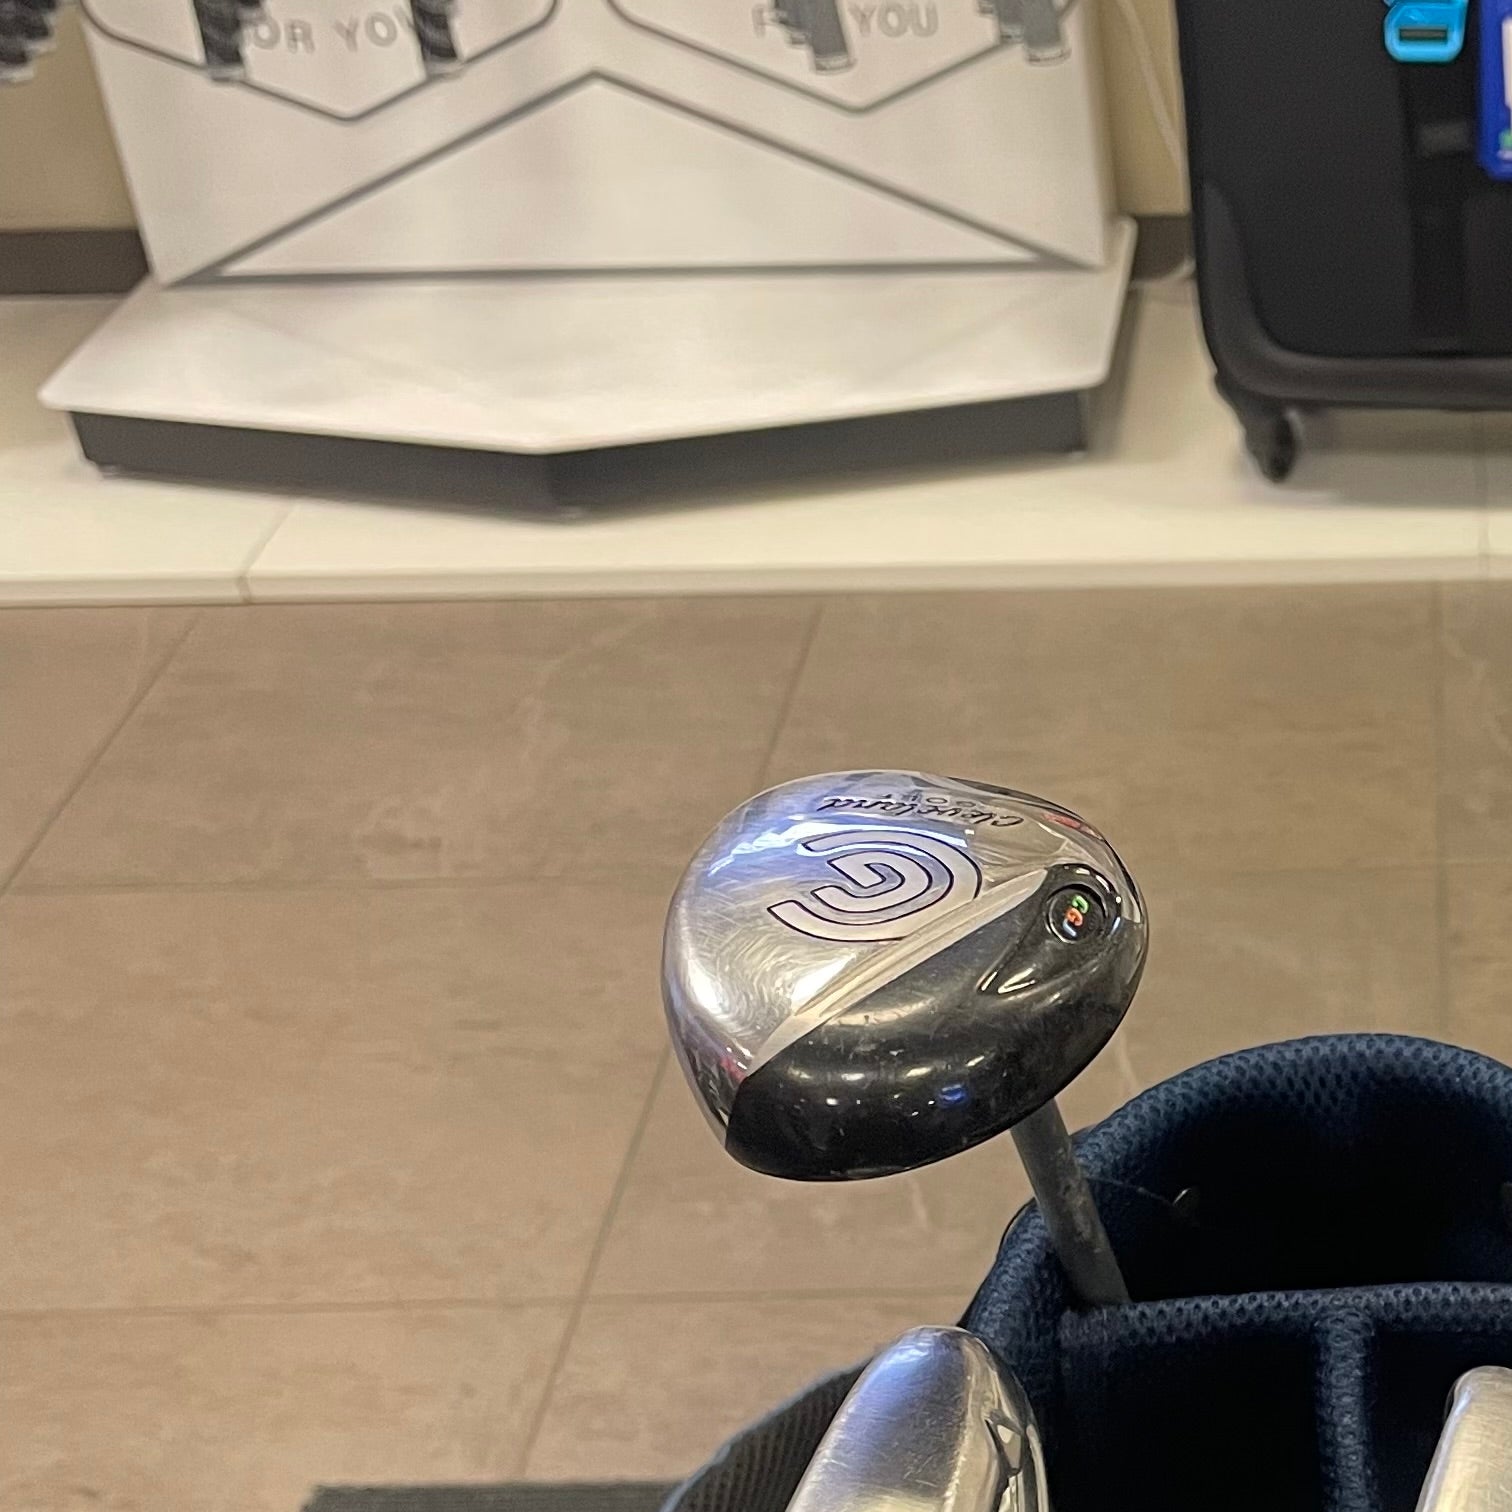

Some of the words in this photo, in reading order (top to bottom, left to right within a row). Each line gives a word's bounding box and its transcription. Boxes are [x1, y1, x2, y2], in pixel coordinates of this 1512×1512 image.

[252, 16, 317, 54] OR
[849, 2, 939, 38] YOU
[816, 796, 1025, 828] Cleveland
